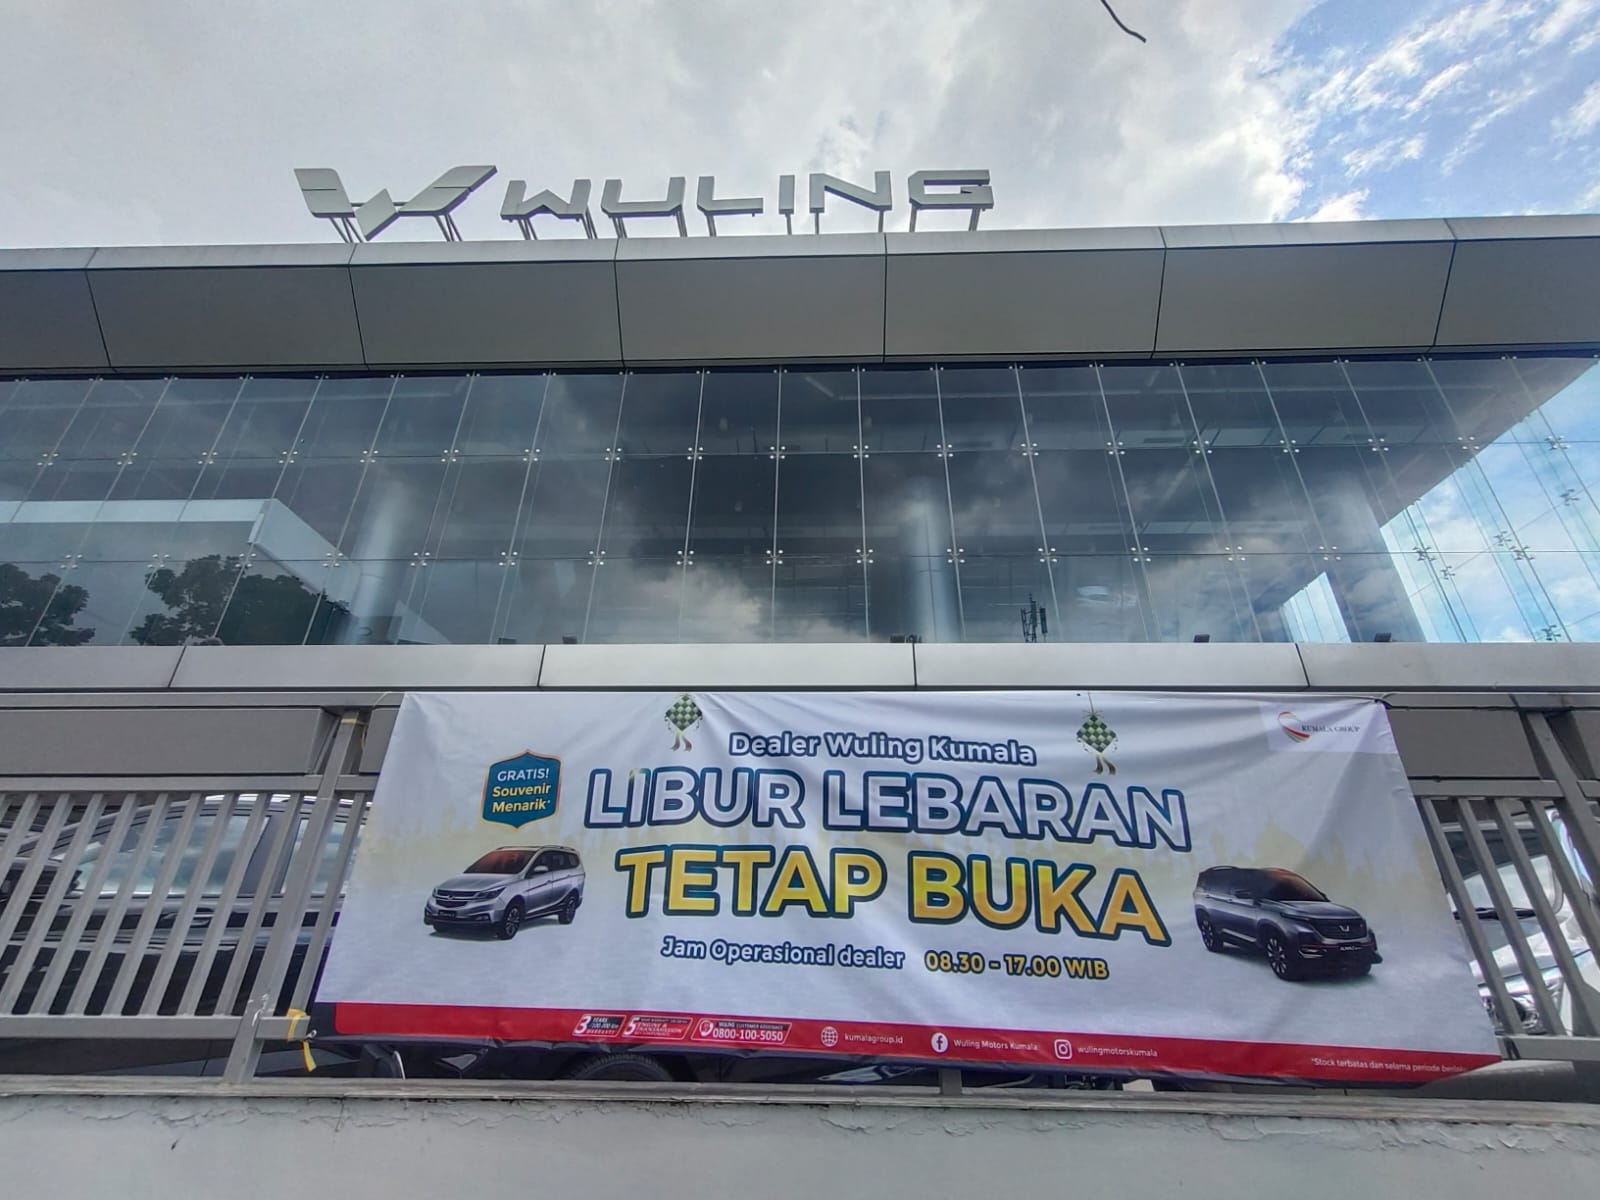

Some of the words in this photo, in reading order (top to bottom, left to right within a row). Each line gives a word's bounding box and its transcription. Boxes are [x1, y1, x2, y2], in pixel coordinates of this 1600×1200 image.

[500, 169, 994, 219] WULING
[729, 731, 819, 758] Dealer
[824, 733, 923, 763] Wuling
[927, 735, 1037, 766] Kumala
[497, 768, 549, 782] GRATIS!
[492, 782, 551, 798] Souvenir
[584, 766, 805, 829] LIBUR
[823, 770, 1192, 852] LEBARAN
[615, 844, 887, 918] TETAP
[908, 851, 1172, 947] BUKA
[660, 936, 705, 959] Jam
[710, 939, 835, 967] Operasional
[837, 945, 905, 970] dealer
[924, 952, 985, 975] 08.30
[1004, 954, 1062, 978] 17.00
[1065, 957, 1110, 981] WIB
[574, 1015, 592, 1034] 3
[623, 1016, 641, 1035] 5
[712, 1028, 784, 1041] 0800-100-5050
[844, 1033, 904, 1045] kumalagroup.id
[953, 1039, 980, 1049] Wuling
[981, 1041, 1009, 1049] Motors
[1010, 1041, 1038, 1050] Kumala
[1077, 1045, 1158, 1057] wulingmotorskumala
